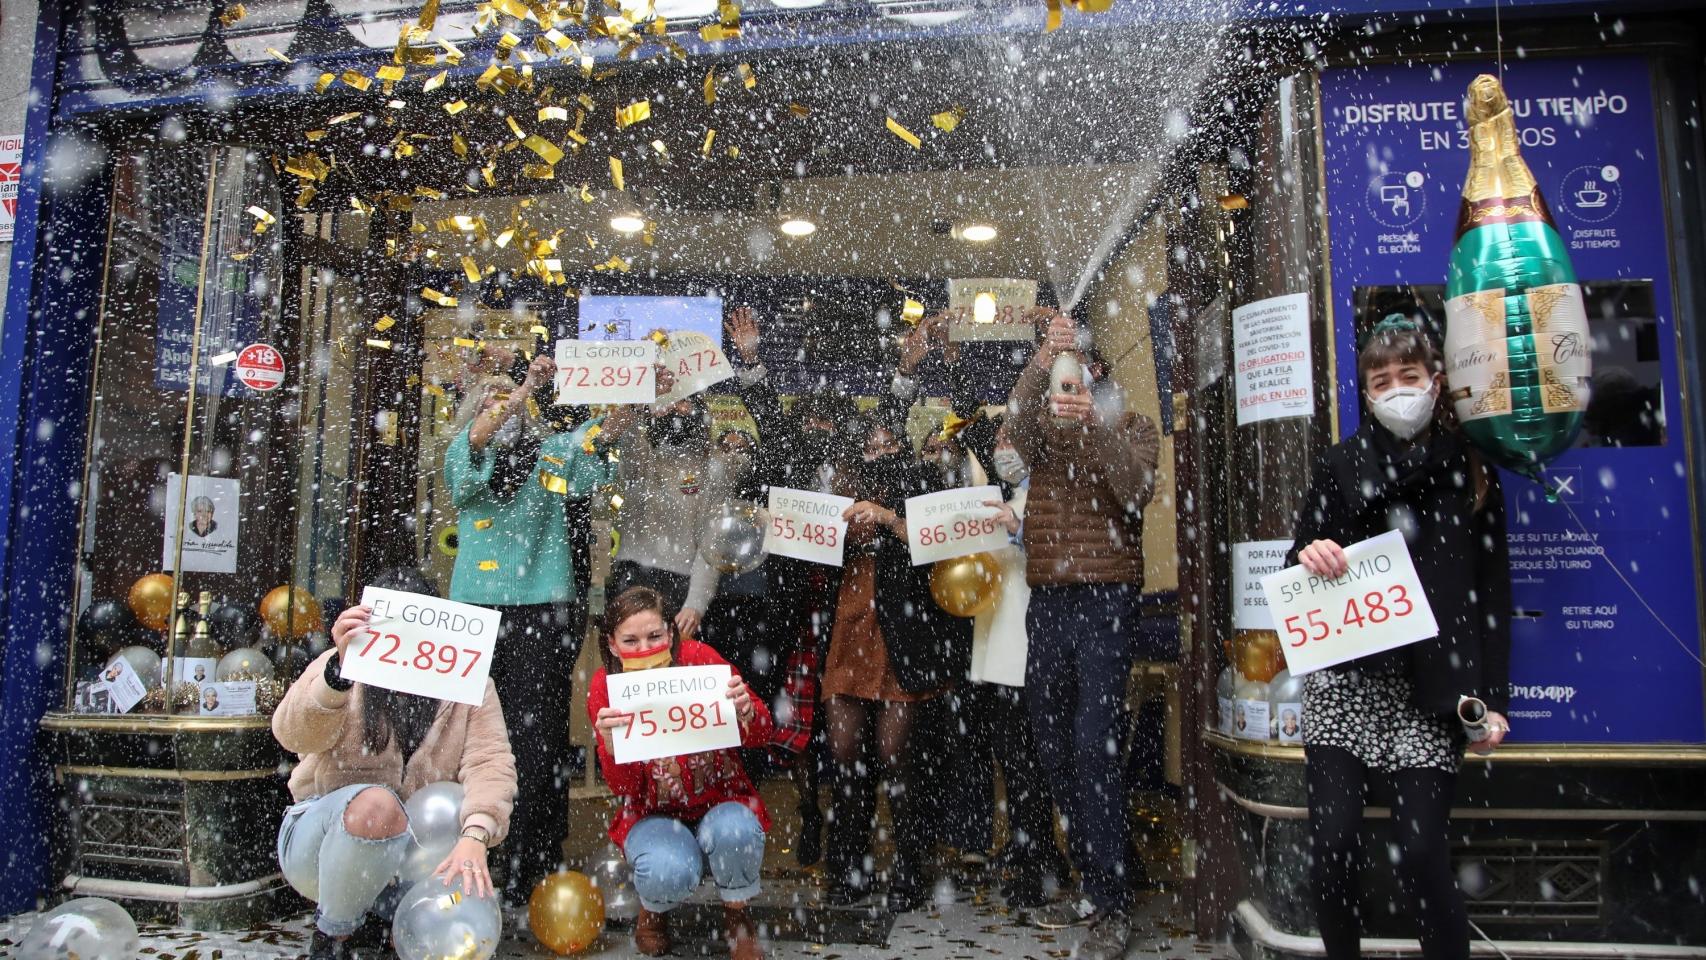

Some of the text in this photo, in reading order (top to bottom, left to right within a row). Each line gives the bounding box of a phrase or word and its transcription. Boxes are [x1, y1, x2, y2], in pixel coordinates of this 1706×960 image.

[1345, 101, 1456, 124] DISFRUTE
[1536, 95, 1628, 117] TIEMPO
[1421, 130, 1450, 150] EN
[1457, 129, 1471, 149] 3
[1571, 240, 1584, 249] SU
[564, 346, 645, 358] EL GORDO
[1258, 341, 1290, 352] COVID-19
[248, 349, 276, 364] +18
[1247, 351, 1305, 368] OBLIGATORIO
[560, 366, 648, 387] 72.897
[1247, 365, 1293, 380] QUE LA FILA
[1258, 377, 1291, 388] REALICE
[1270, 391, 1282, 400] EN
[1284, 388, 1308, 399] UNO
[776, 500, 839, 518] 5º PREMIO
[772, 517, 838, 548] 55.483
[919, 517, 995, 546] 86.986
[1527, 533, 1540, 542] SU
[1591, 533, 1599, 541] Y
[1248, 550, 1263, 559] POR
[1528, 547, 1542, 556] UN
[1543, 547, 1563, 555] SMS
[1564, 546, 1605, 555] CUANDO
[1545, 560, 1558, 570] SU
[1559, 560, 1592, 569] TURNO
[1245, 581, 1254, 591] LA
[1280, 554, 1392, 603] 5º PREMIO
[1243, 597, 1252, 607] DE
[1562, 604, 1618, 615] RETIRE AQUÍ
[371, 599, 484, 636] EL GORDO
[1284, 584, 1413, 648] 55.483
[1565, 620, 1615, 630] SU TURNO
[358, 629, 482, 678] 72.897
[621, 676, 717, 700] 4º PREMIO
[618, 701, 727, 740] 75.981
